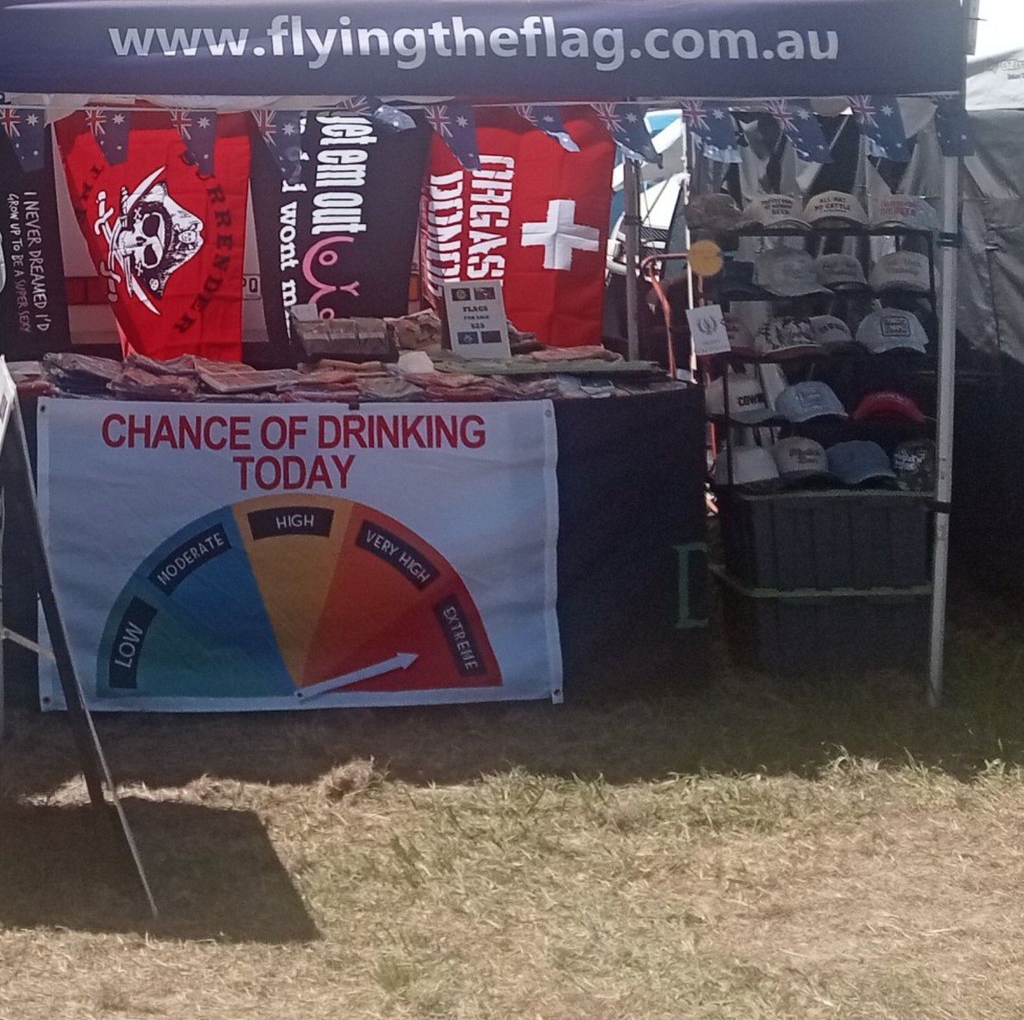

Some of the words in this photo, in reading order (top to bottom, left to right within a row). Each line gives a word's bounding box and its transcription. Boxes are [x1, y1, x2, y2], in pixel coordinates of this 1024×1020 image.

[108, 15, 839, 71] www.flyingtheflag.com.au
[315, 149, 368, 187] em
[7, 193, 20, 220] GROW
[23, 200, 42, 247] NEVER
[311, 192, 366, 235] out
[466, 154, 515, 286] ORGAS
[9, 223, 21, 236] UP
[175, 152, 233, 334] RRENDER
[280, 201, 299, 271] wont
[11, 254, 24, 267] BE
[28, 250, 47, 309] DREAMED
[14, 279, 29, 309] SUPER
[18, 310, 31, 332] SEXY
[34, 314, 52, 332] I'D
[101, 413, 251, 450] CHANCE
[260, 415, 308, 450] OF
[318, 414, 487, 449] DRINKING
[233, 454, 356, 490] TODAY
[276, 514, 315, 530] HIGH
[157, 532, 224, 586] MODERATE
[364, 529, 396, 557] VERY
[398, 553, 431, 585] HIGH
[114, 620, 144, 669] LOW
[442, 605, 480, 671] EXTREME
